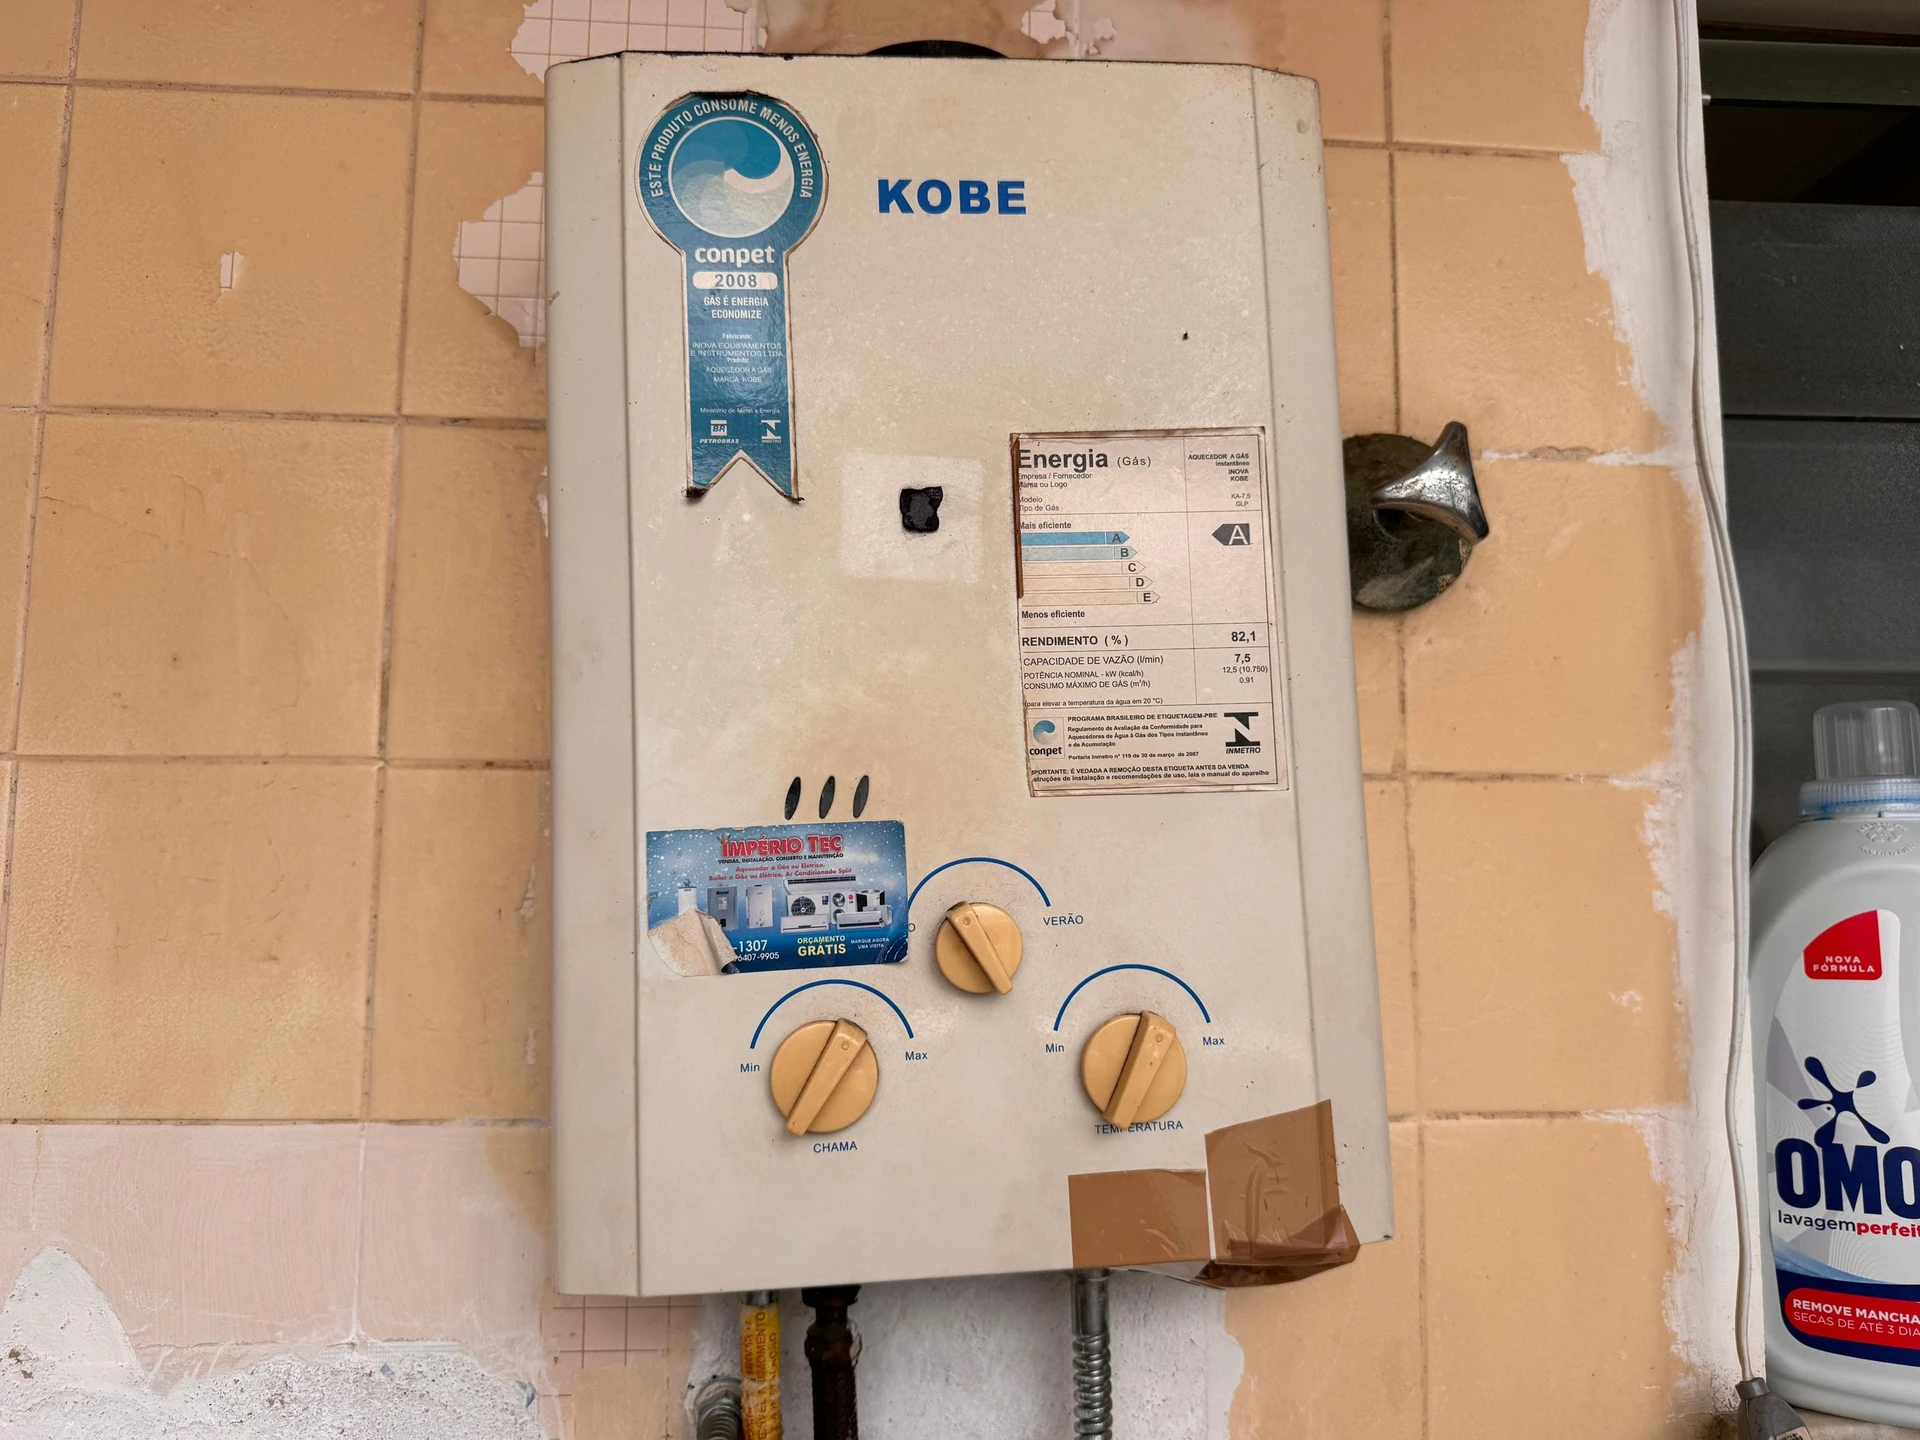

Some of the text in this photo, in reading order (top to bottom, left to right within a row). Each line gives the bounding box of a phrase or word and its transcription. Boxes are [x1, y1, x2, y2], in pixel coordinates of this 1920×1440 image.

[648, 98, 814, 198] ESTE PRODUTO CONSOME MENOS ENERGIA
[878, 178, 1027, 215] KOBE
[694, 245, 776, 268] conpet
[714, 274, 758, 288] 2008
[704, 295, 769, 307] GÁS É ENERGIA
[711, 310, 762, 320] ECONOMIZE
[1018, 448, 1152, 474] Energia (Gás)
[1038, 521, 1072, 529] eficiente
[1112, 533, 1122, 543] A
[1228, 525, 1249, 546] A
[1120, 548, 1129, 558] B
[1128, 562, 1137, 572] C
[1136, 578, 1145, 587] D
[1143, 592, 1152, 602] E
[1022, 610, 1085, 618] Menos eficiente
[1022, 636, 1098, 646] RENDIMENTO
[1231, 630, 1256, 644] 82,1
[1023, 656, 1084, 666] CAPACIDADE
[1087, 656, 1100, 664] DE
[1102, 654, 1134, 664] VAZÃO
[1234, 653, 1251, 664] 7,5
[1024, 670, 1062, 680] POTÊNCIA
[1118, 670, 1144, 678] (kcal/h)
[1223, 665, 1268, 674] 12,5 (10.750)
[1066, 680, 1098, 689] MÁXIMO
[1112, 680, 1128, 688] GÁS
[1029, 746, 1062, 756] conpet
[721, 834, 843, 858] IMPÉRIO TEC
[808, 852, 844, 860] MANUTENÇÃO
[794, 868, 837, 876] Condicionado
[1042, 912, 1084, 926] VERÃO
[797, 934, 846, 944] ORÇAMENTO
[797, 942, 846, 956] GRÁTIS
[737, 952, 780, 962] 6407-9905
[1825, 956, 1861, 964] NOVA
[1812, 963, 1875, 973] FÓRMULA
[1202, 1036, 1225, 1046] Max
[1045, 1042, 1065, 1054] Min
[905, 1050, 928, 1061] Max
[740, 1062, 760, 1073] Min
[1094, 1120, 1184, 1134] TEMERATURA
[812, 1140, 858, 1154] CHAMA
[1774, 1137, 1920, 1220] OMO
[1792, 1298, 1920, 1325] REMOVE MANCHA
[1794, 1311, 1834, 1326] SECAS
[1838, 1318, 1856, 1330] DE
[1858, 1321, 1884, 1333] ATÉ
[1887, 1324, 1895, 1335] 3
